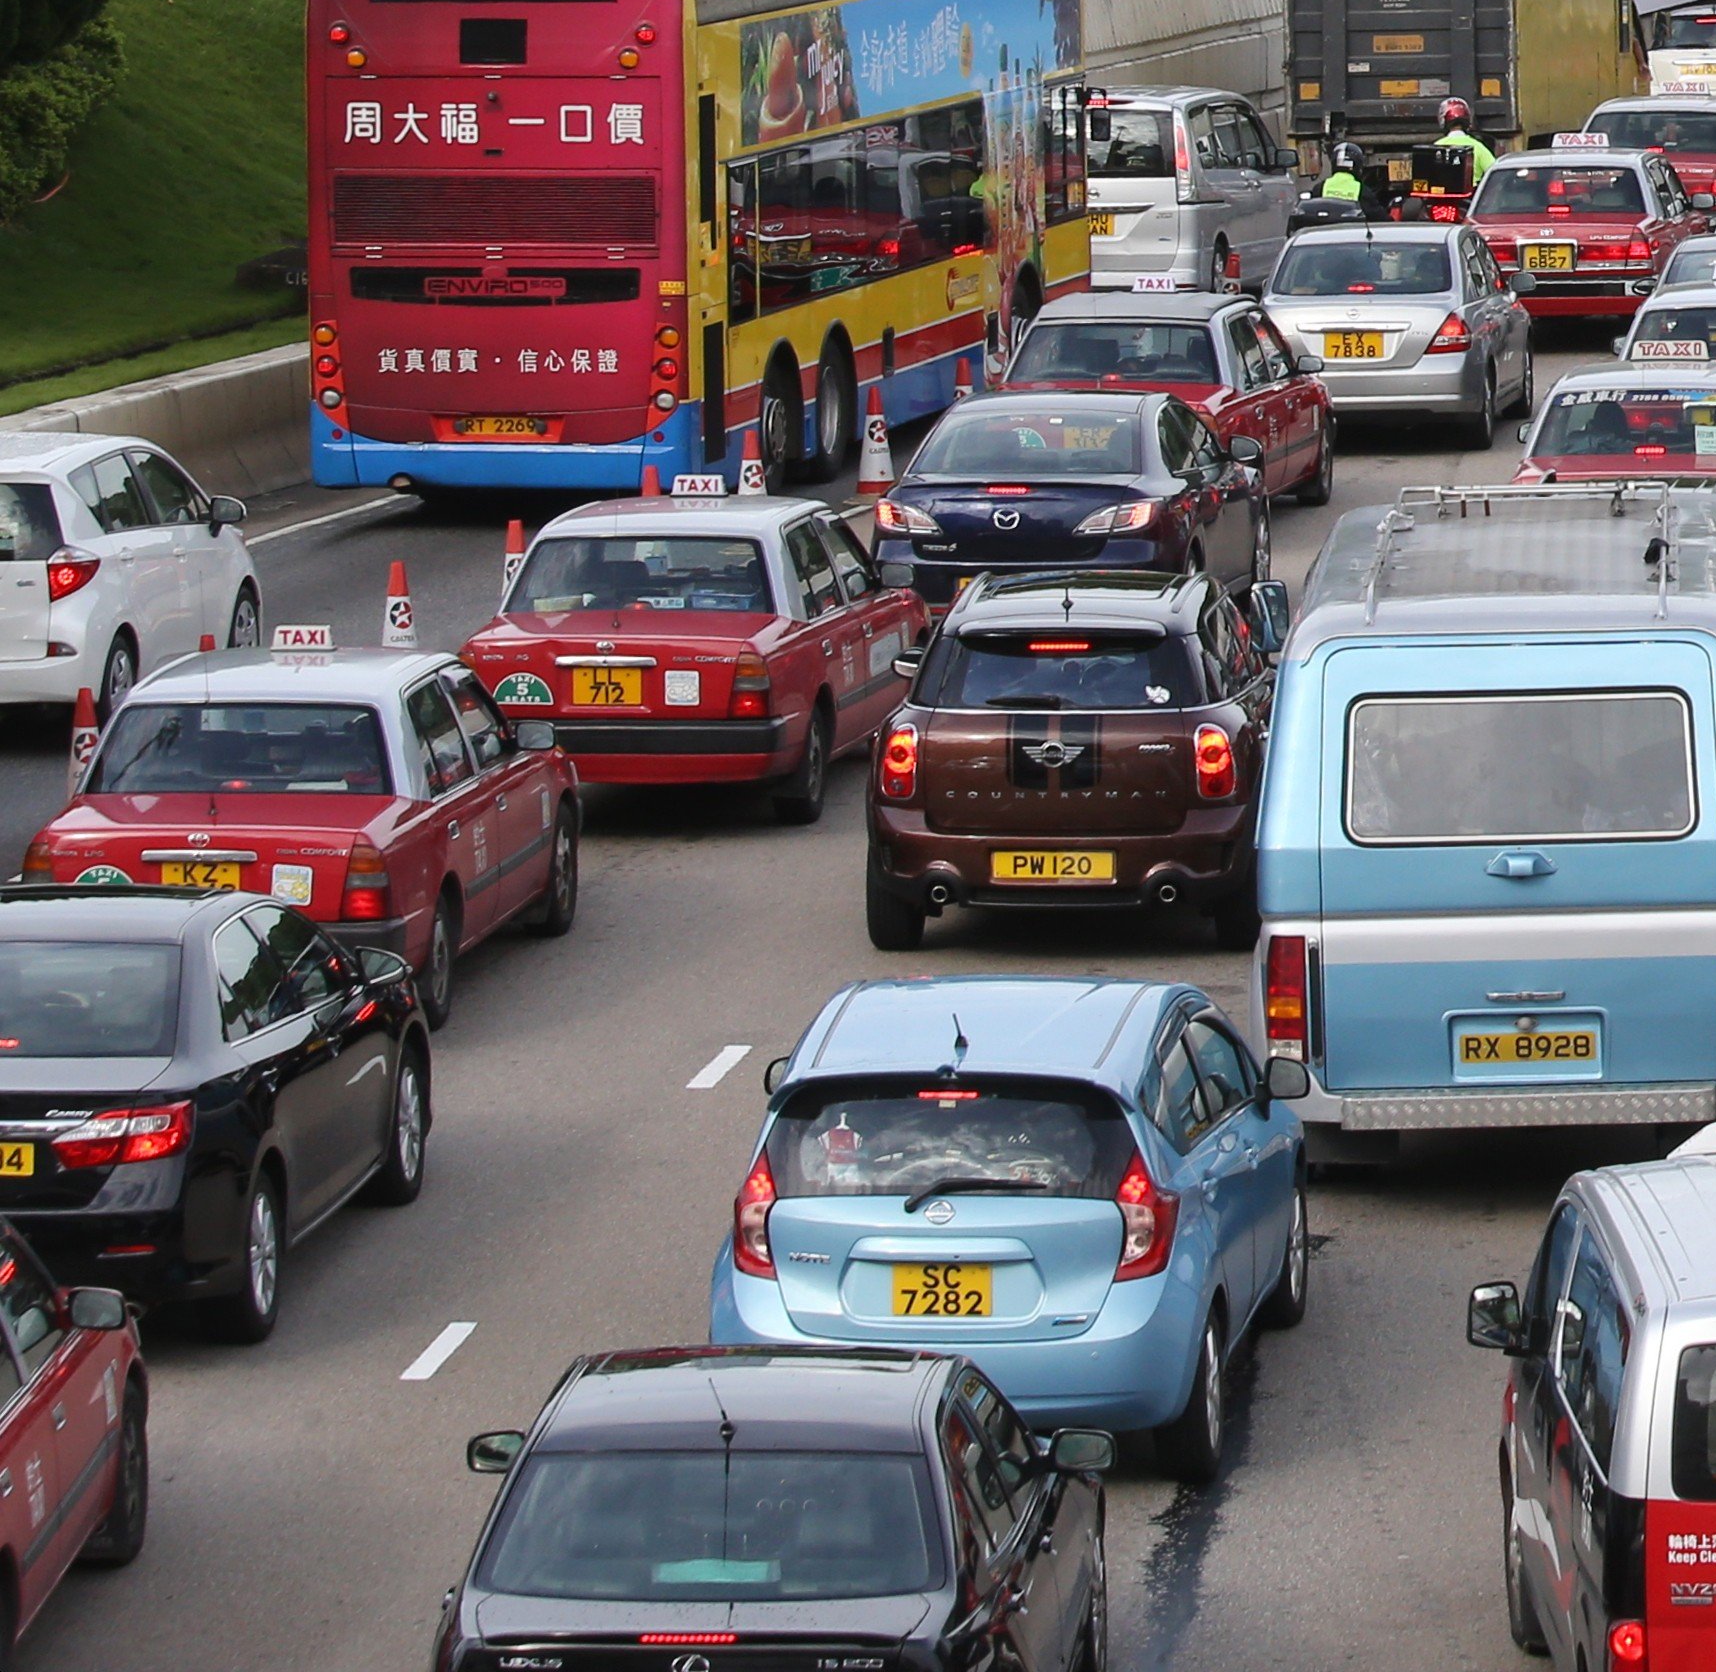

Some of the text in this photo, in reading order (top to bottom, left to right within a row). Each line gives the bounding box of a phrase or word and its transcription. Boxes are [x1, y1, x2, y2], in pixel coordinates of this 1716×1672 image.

[1663, 82, 1707, 94] TAXI
[344, 101, 644, 145] 周大福 一口價
[1558, 133, 1605, 146] TAXI
[1529, 257, 1567, 269] 6827
[1137, 278, 1171, 290] TAXI
[1342, 332, 1364, 346] EX
[1331, 345, 1376, 358] 7838
[1638, 342, 1702, 356] TAXI
[378, 348, 619, 374] 貨真價實 信心保證
[465, 418, 536, 433] RT 2269
[676, 478, 721, 494] TAXI
[278, 629, 326, 646] TAXI
[593, 668, 620, 687] LL
[516, 682, 529, 695] 5
[589, 686, 625, 703] 712
[504, 695, 541, 704] SEATS
[945, 790, 1168, 799] COUNTRYMAN
[1012, 854, 1092, 875] PW 120
[182, 862, 217, 883] KZ
[1462, 1034, 1592, 1059] RX 8928
[788, 1251, 831, 1265] NOTE
[922, 1266, 962, 1288] SC
[901, 1290, 984, 1315] 7282
[1668, 1550, 1698, 1566] Keep
